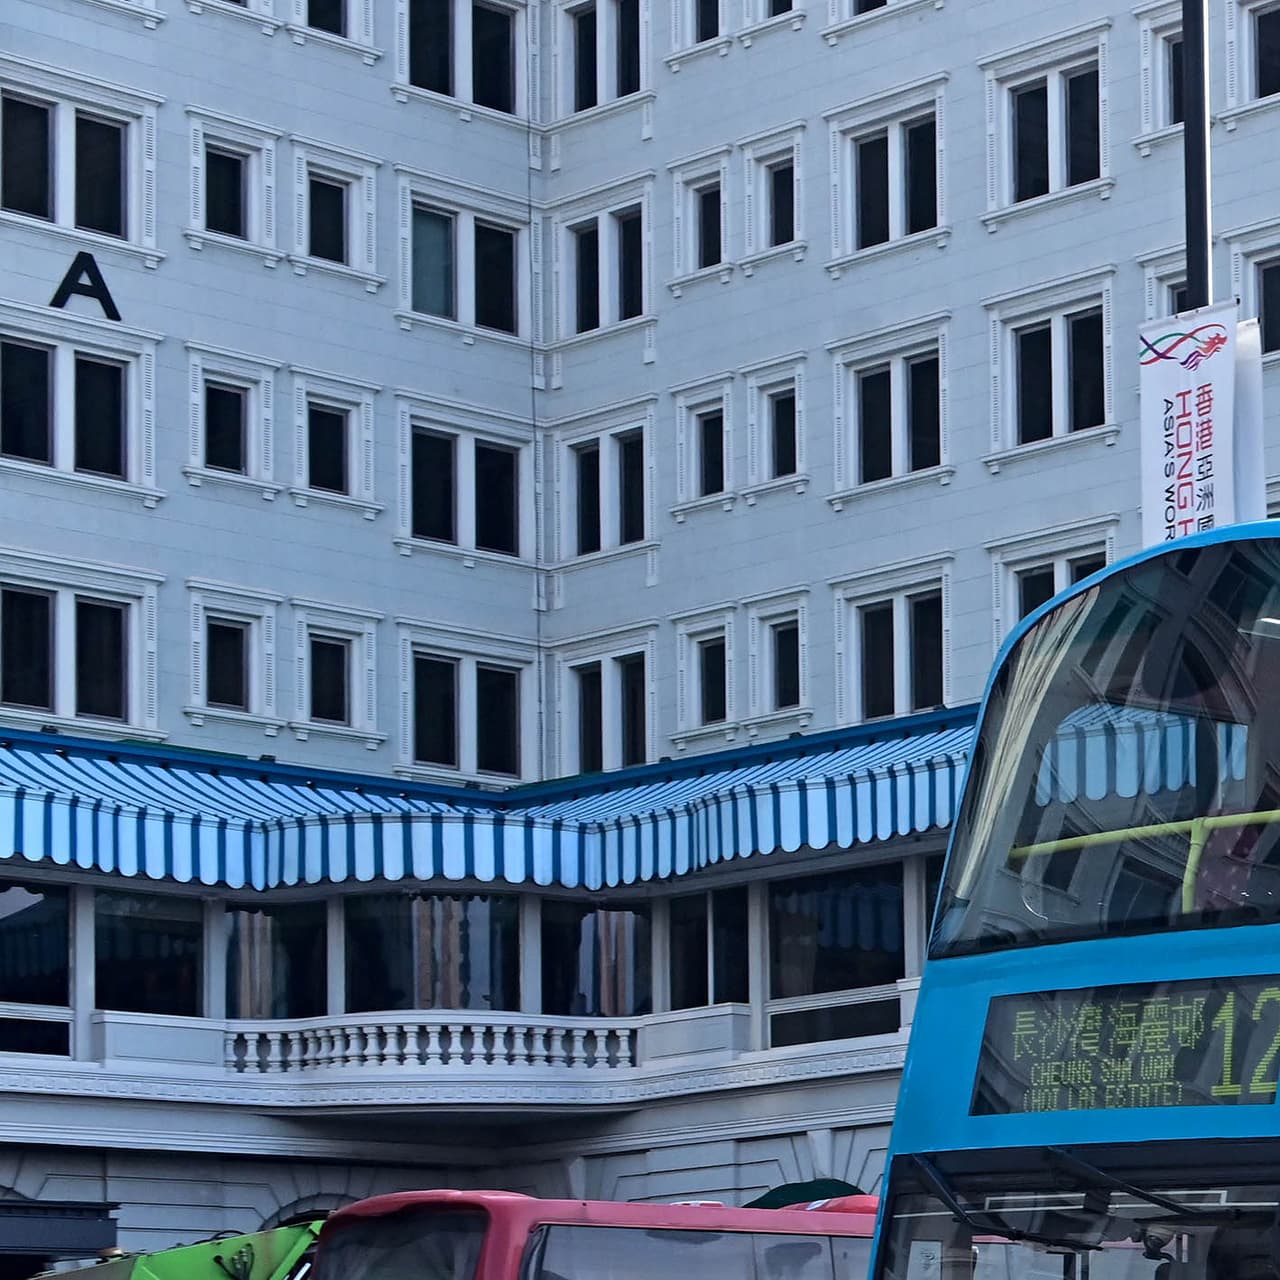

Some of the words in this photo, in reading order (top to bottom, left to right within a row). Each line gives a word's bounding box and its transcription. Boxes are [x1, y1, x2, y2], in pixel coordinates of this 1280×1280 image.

[49, 251, 122, 322] A
[1163, 398, 1176, 478] ASIA'S
[1175, 389, 1195, 510] HONG
[1031, 1060, 1093, 1087] CHEUNG
[1100, 1057, 1132, 1082] SHA
[1140, 1054, 1175, 1080] WAN
